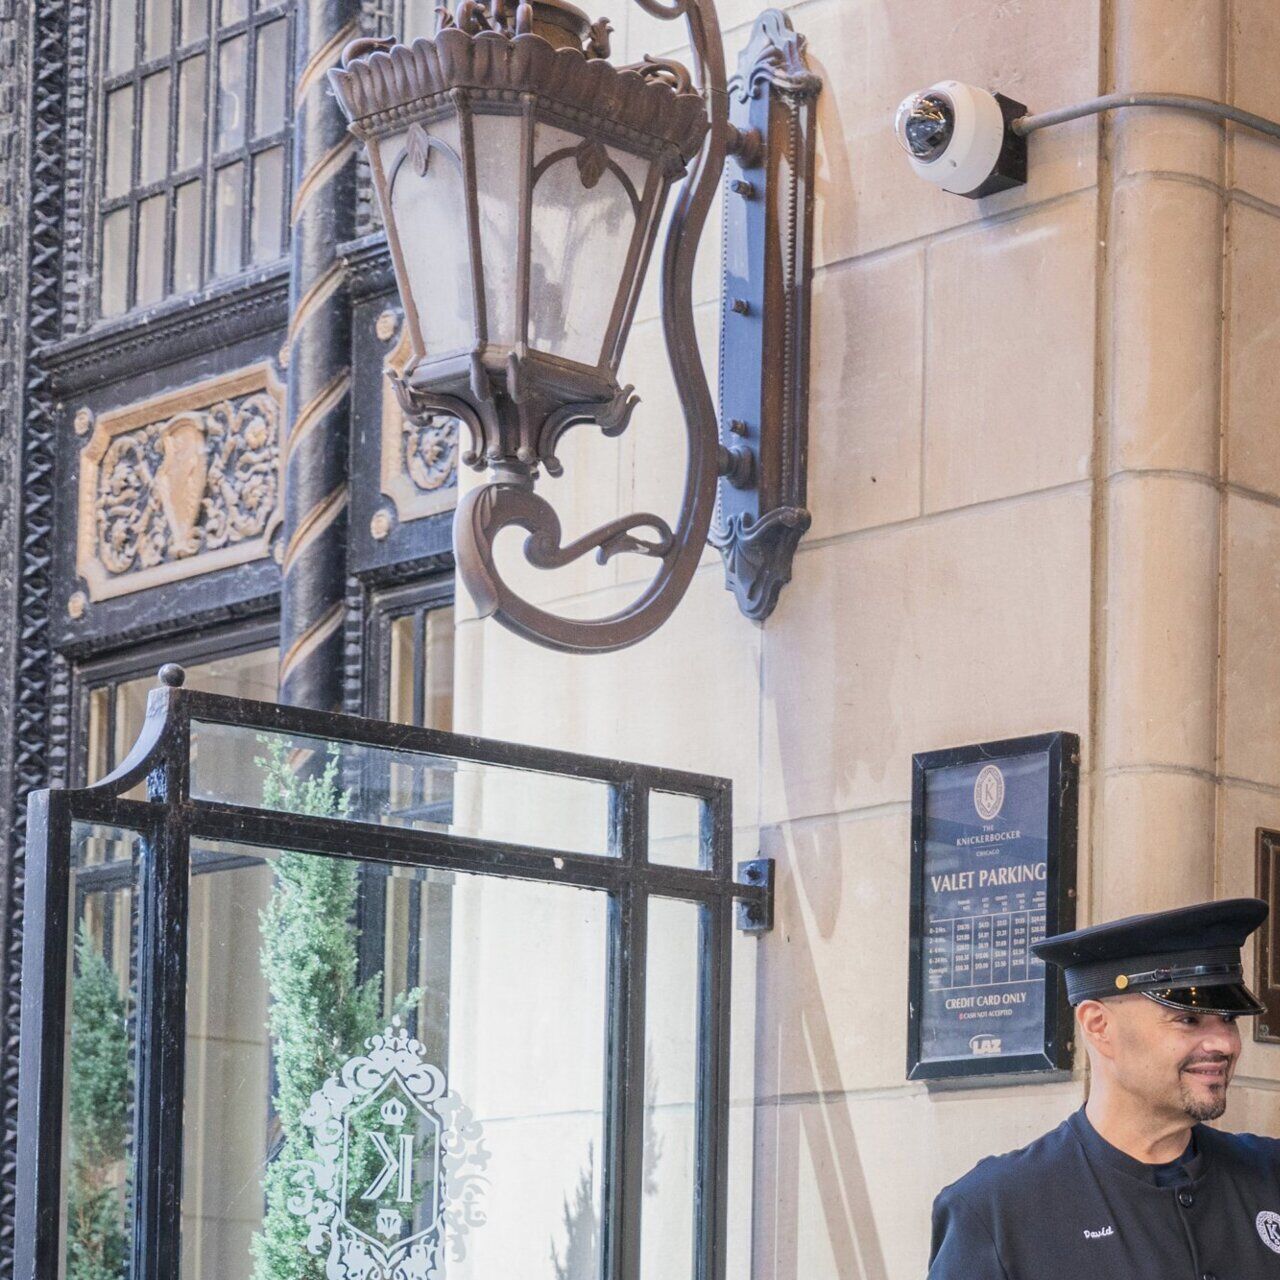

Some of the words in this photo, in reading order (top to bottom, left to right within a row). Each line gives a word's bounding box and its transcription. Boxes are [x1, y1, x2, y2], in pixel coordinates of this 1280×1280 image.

[982, 824, 994, 832] THE
[956, 830, 1021, 846] KNICKERBOCKER
[975, 848, 1000, 857] CHICAGO
[931, 871, 975, 893] VALET
[979, 862, 1047, 888] PARKING
[945, 997, 975, 1010] CREDIT
[976, 995, 1001, 1008] CARD
[1002, 991, 1027, 1004] ONLY
[988, 1009, 1013, 1017] ACCEPTED
[972, 1038, 1002, 1055] LAZ
[1083, 1225, 1115, 1239] David
